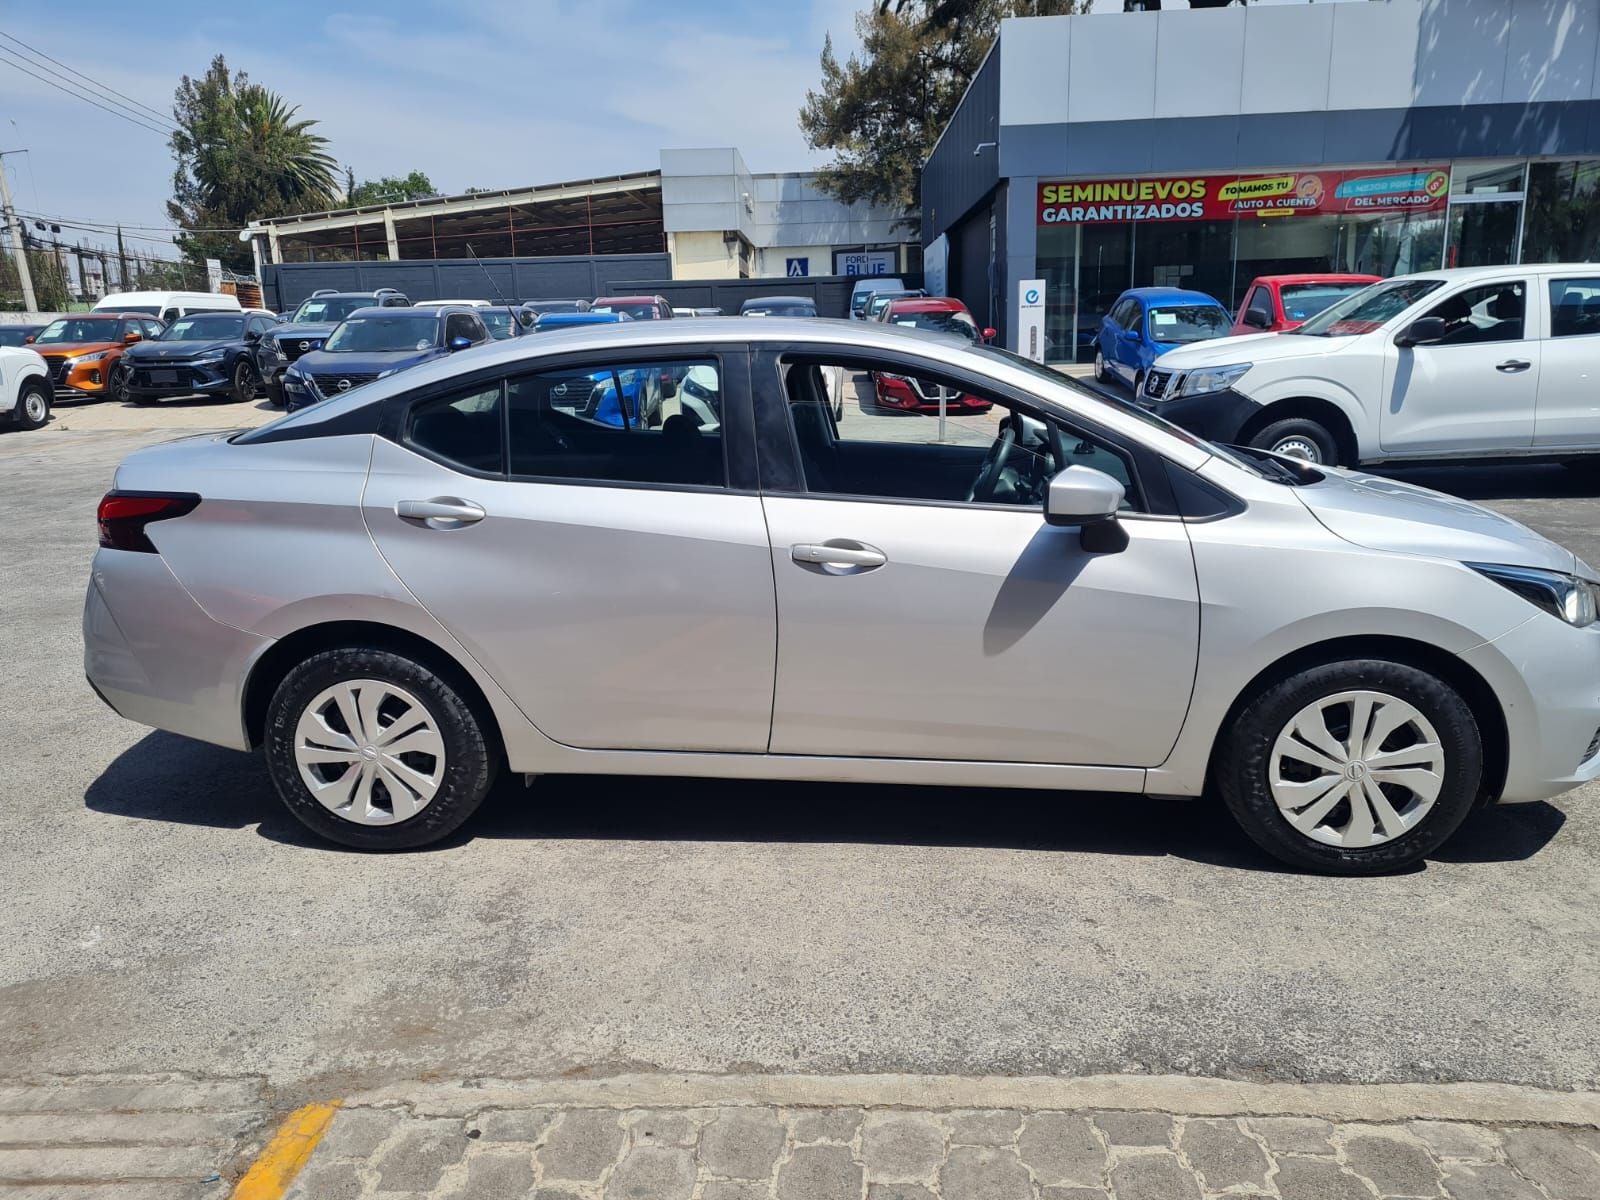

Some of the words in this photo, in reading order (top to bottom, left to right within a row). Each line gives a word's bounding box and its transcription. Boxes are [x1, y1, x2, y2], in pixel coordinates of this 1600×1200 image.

[1042, 180, 1206, 203] SEMINUEVOS
[1225, 183, 1274, 195] TOMAMOS
[1276, 181, 1289, 190] TU
[1234, 199, 1264, 209] AUTO
[1266, 199, 1275, 208] A
[1276, 198, 1317, 207] CUENTA
[1354, 197, 1375, 206] DEL
[1377, 195, 1430, 206] MERCADO
[1042, 202, 1204, 223] GARANTIZADOS
[845, 255, 869, 264] FORD
